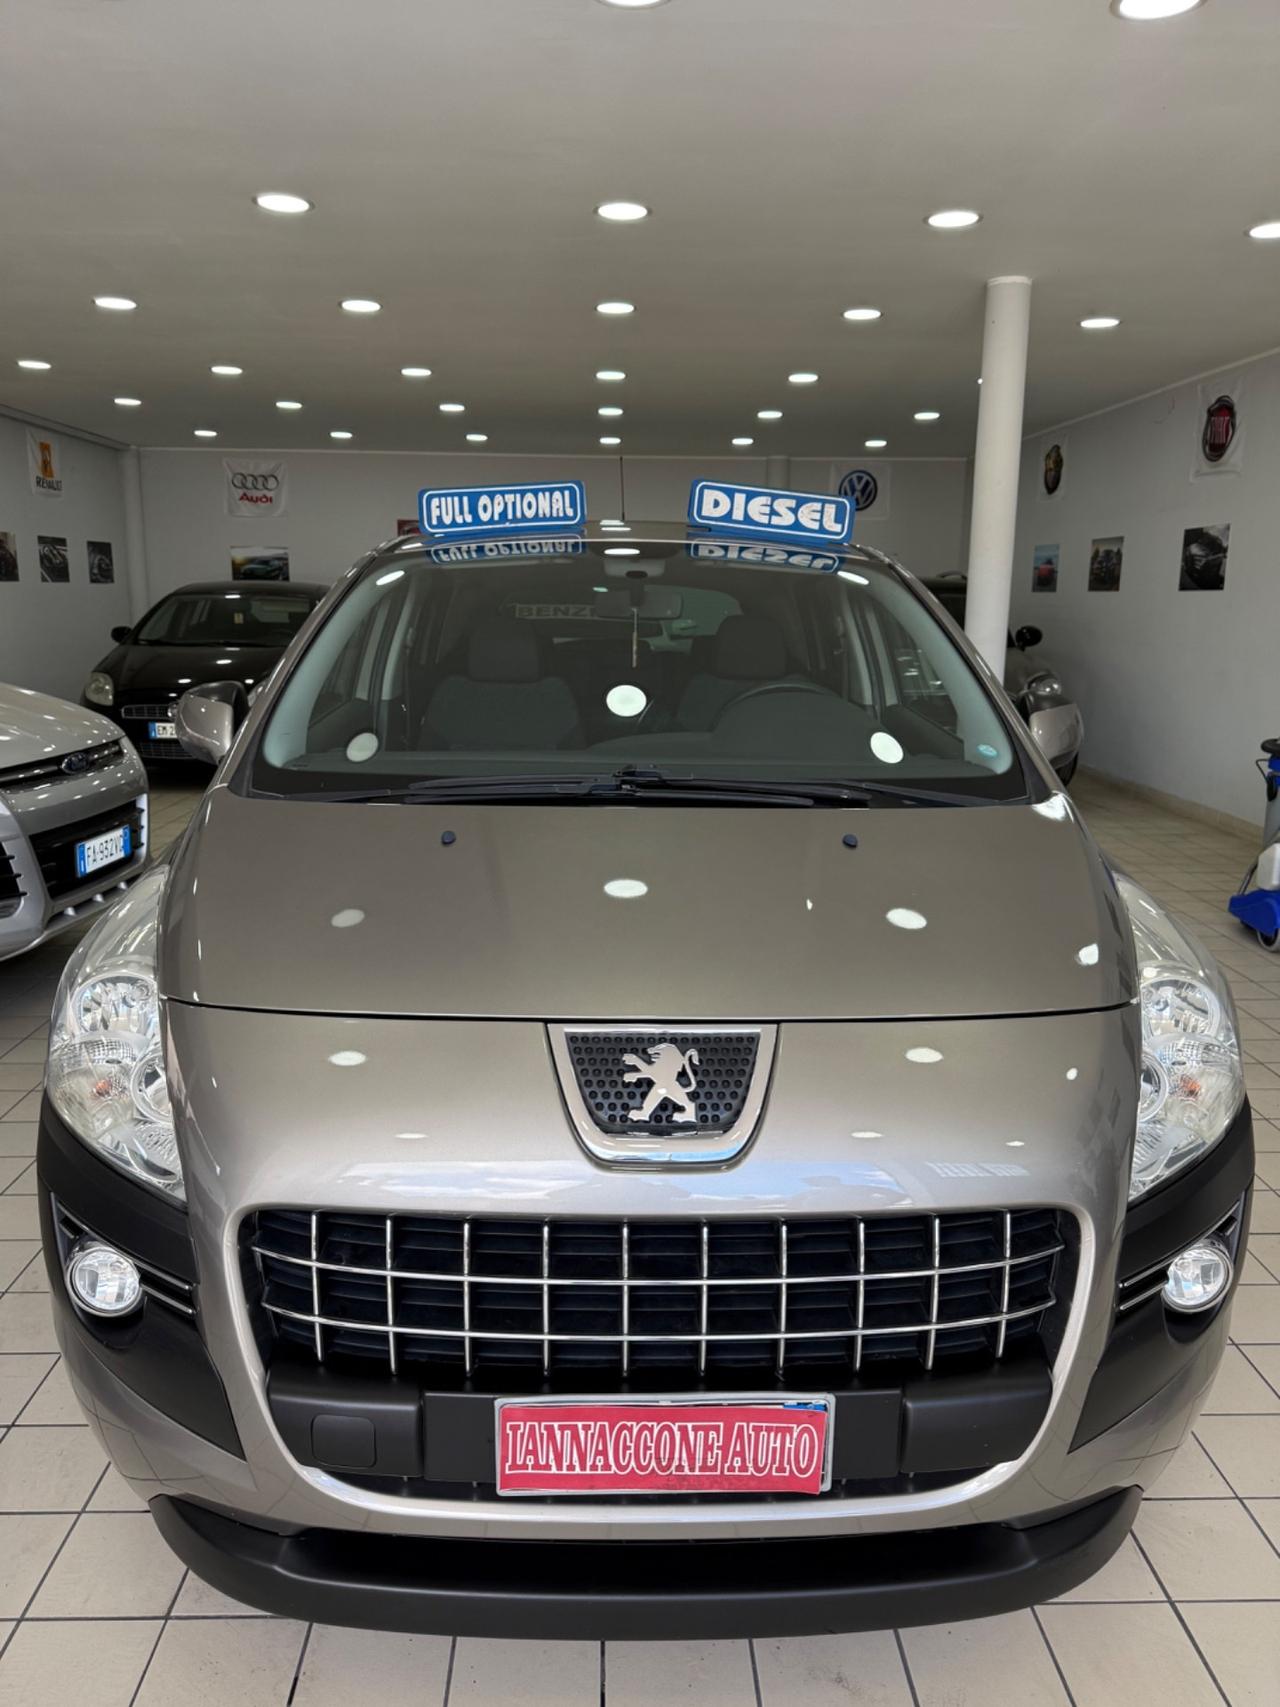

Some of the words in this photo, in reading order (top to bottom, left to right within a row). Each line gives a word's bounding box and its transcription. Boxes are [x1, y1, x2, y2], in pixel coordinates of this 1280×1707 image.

[239, 492, 273, 504] Audi
[430, 495, 473, 526] FULL
[478, 491, 573, 522] OPTIONAL
[701, 488, 843, 533] DIESEL
[506, 1421, 723, 1475] IANNACCONE
[725, 1422, 818, 1478] AUTO
